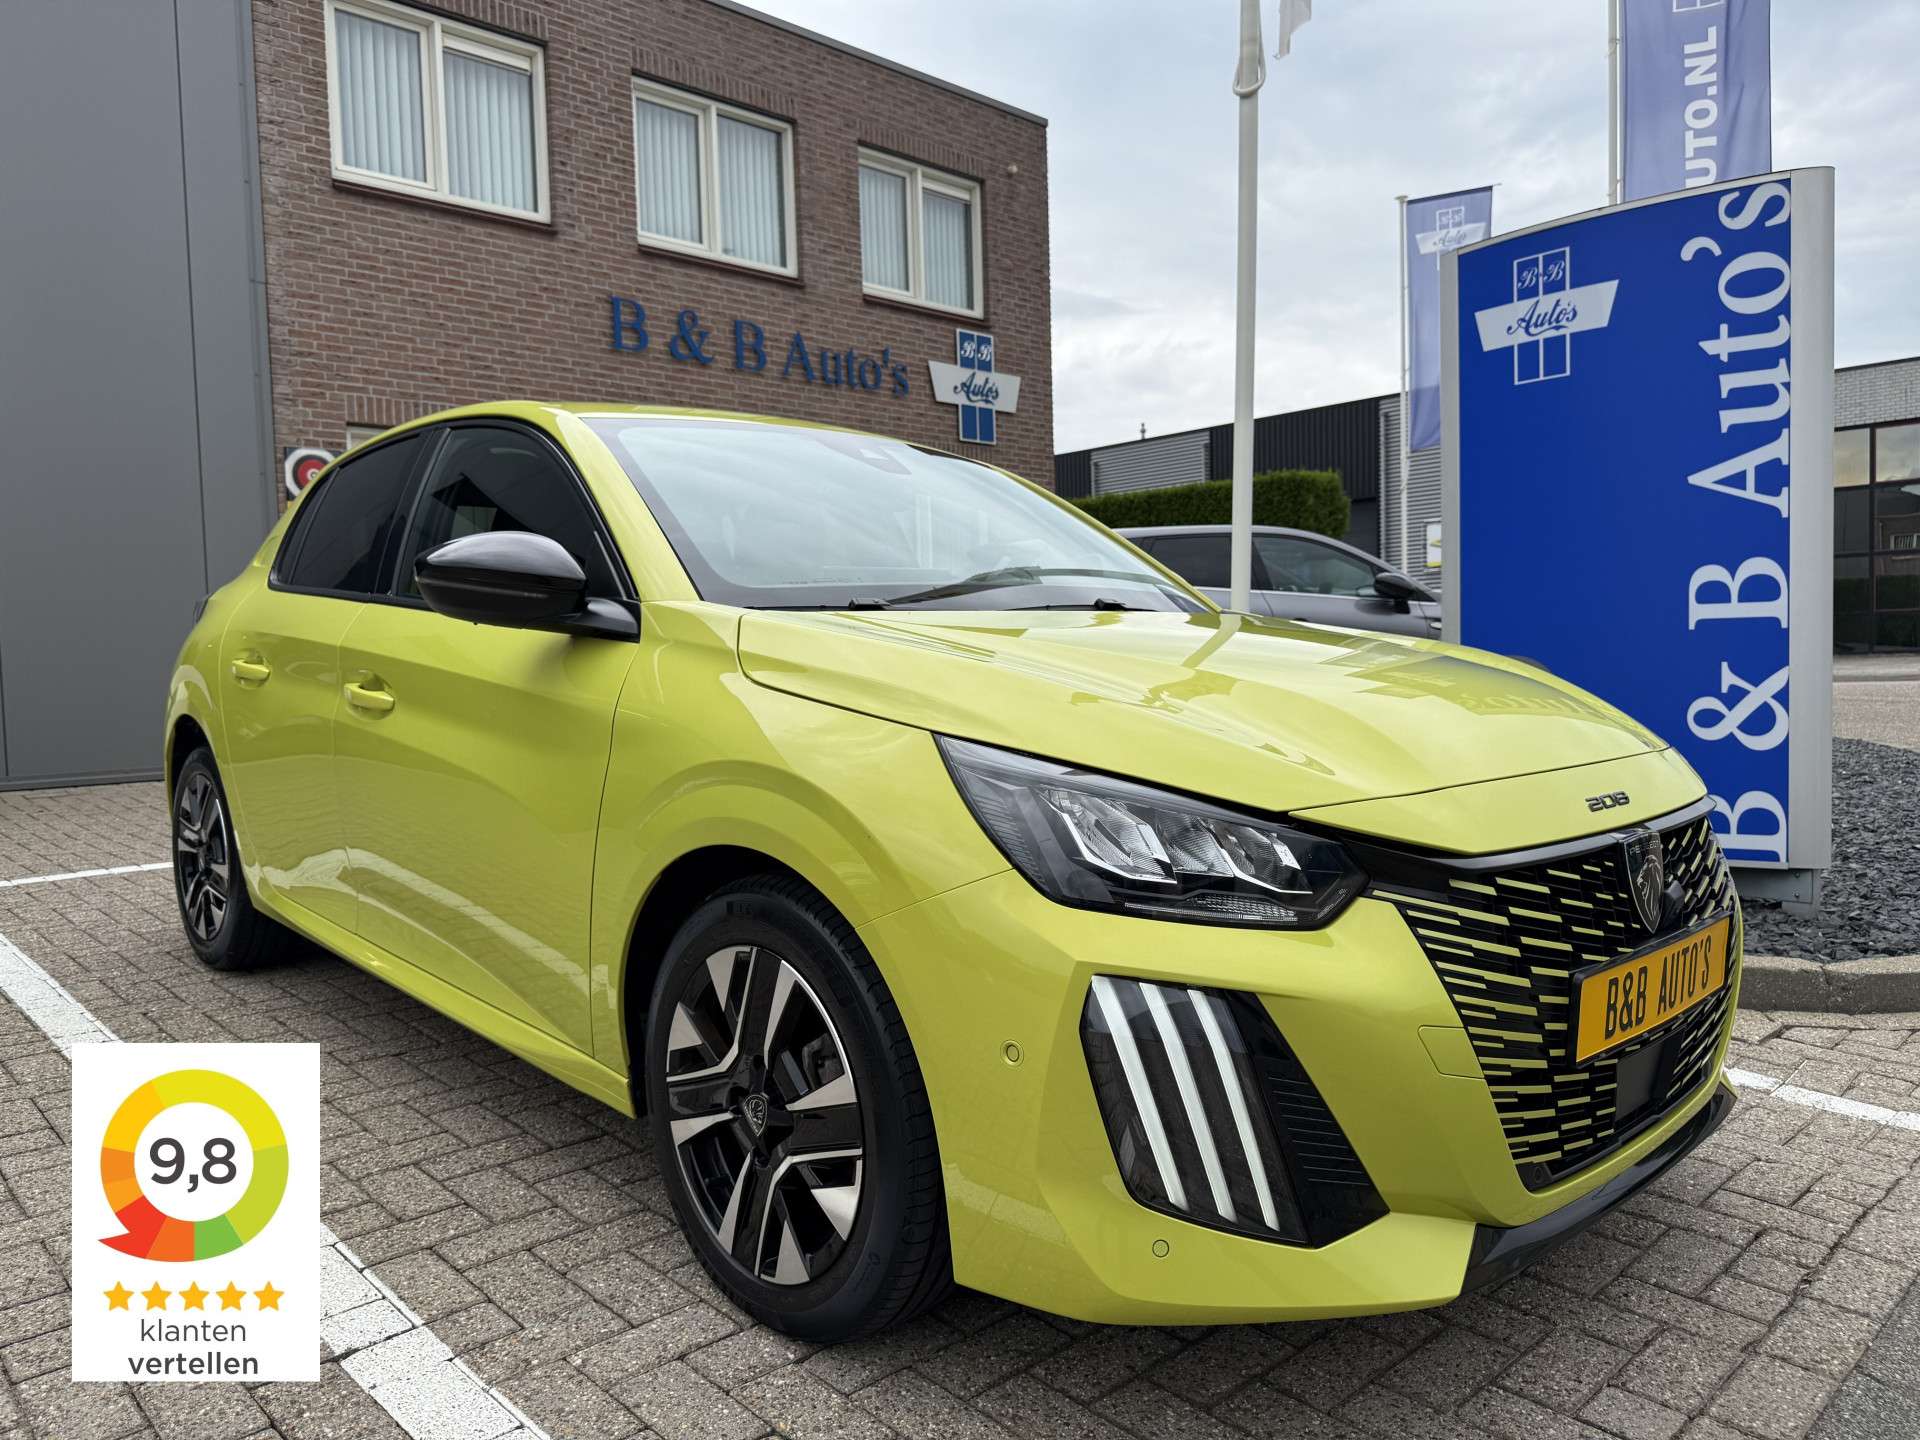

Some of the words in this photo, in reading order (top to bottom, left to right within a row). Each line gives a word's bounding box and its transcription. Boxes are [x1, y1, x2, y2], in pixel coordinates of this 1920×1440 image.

[611, 295, 650, 352] B
[668, 309, 714, 364] &
[733, 319, 767, 372] B
[782, 331, 910, 397] Auto's
[1507, 298, 1577, 337] Auto's
[1680, 182, 1791, 518] Auto's
[953, 371, 999, 405] Auto's
[1688, 557, 1788, 629] B
[1687, 661, 1789, 751] &
[1585, 790, 1630, 812] 208
[1707, 790, 1787, 862] B
[1604, 965, 1648, 1040] B&B
[1657, 934, 1711, 1016] AUTO'S
